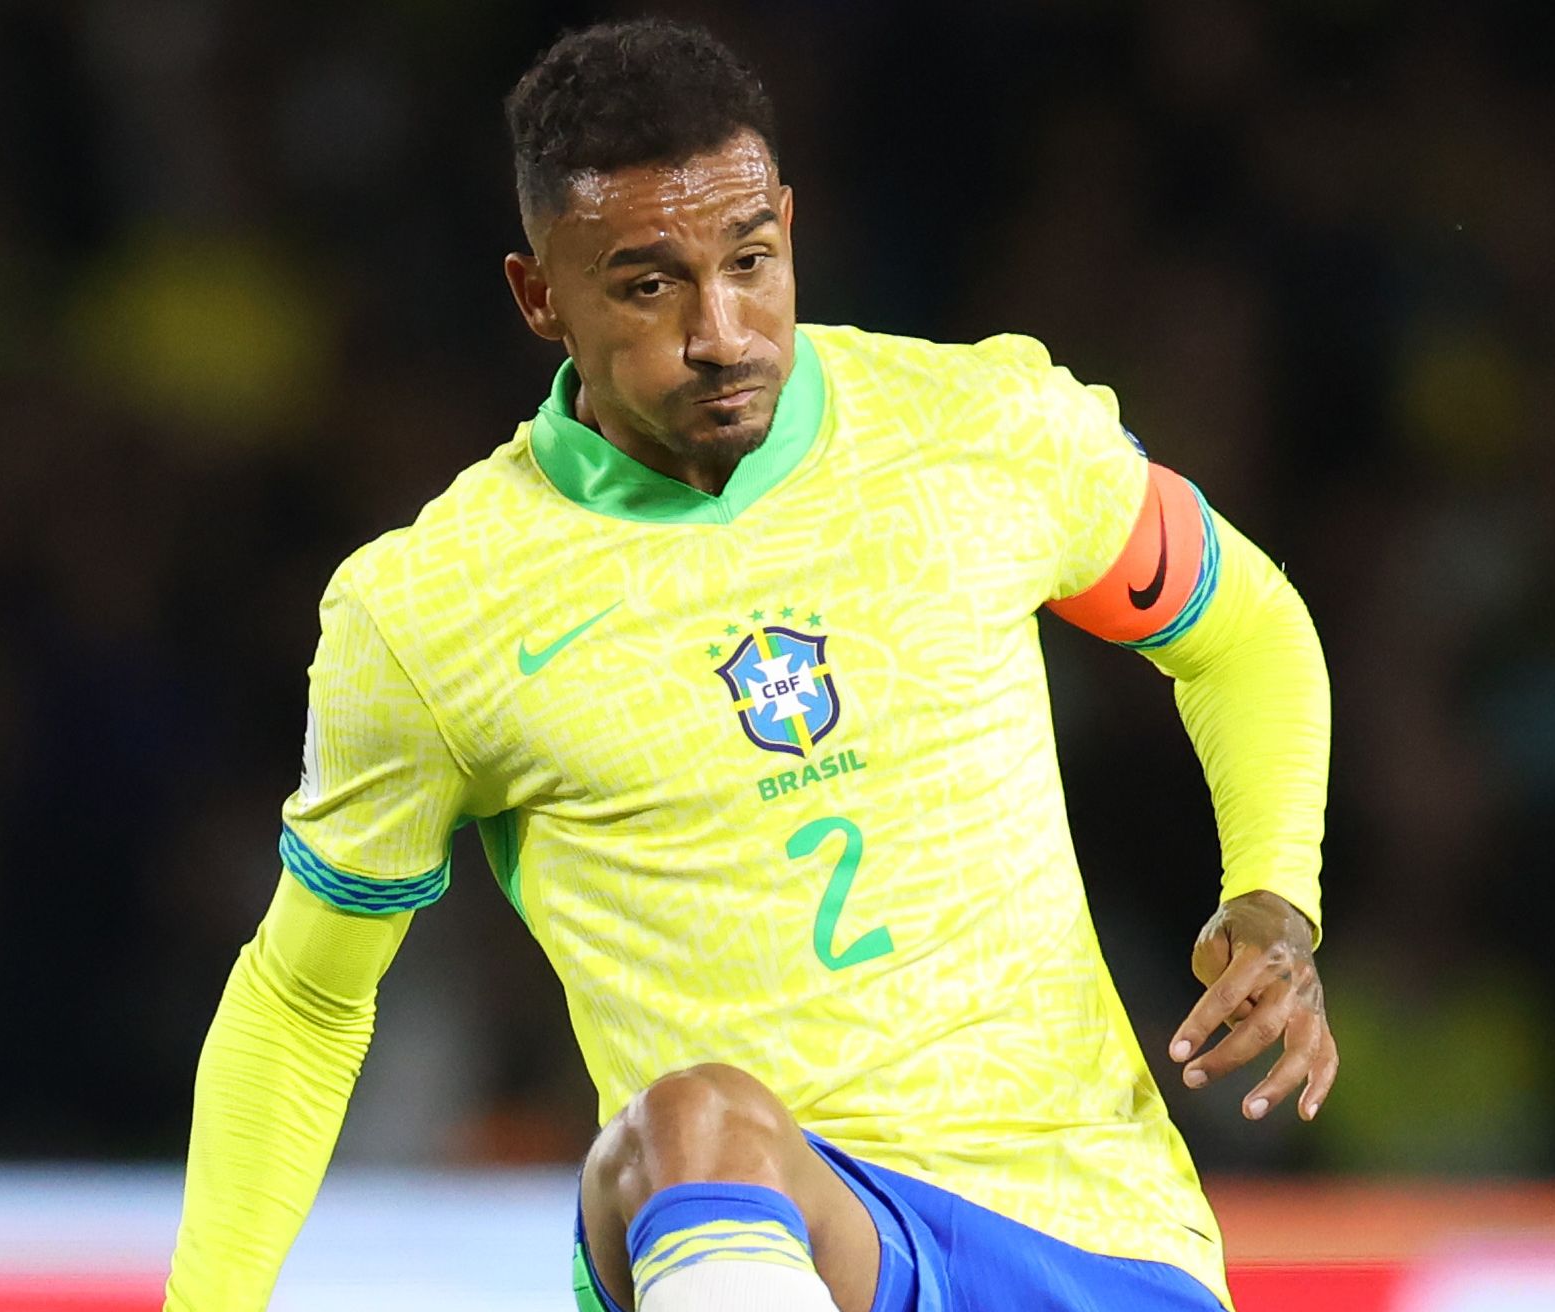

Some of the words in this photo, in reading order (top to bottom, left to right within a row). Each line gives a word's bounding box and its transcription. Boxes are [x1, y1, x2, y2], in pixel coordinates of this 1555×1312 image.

[762, 675, 800, 699] CBF
[757, 749, 867, 801] BRASIL
[785, 816, 894, 971] 2
